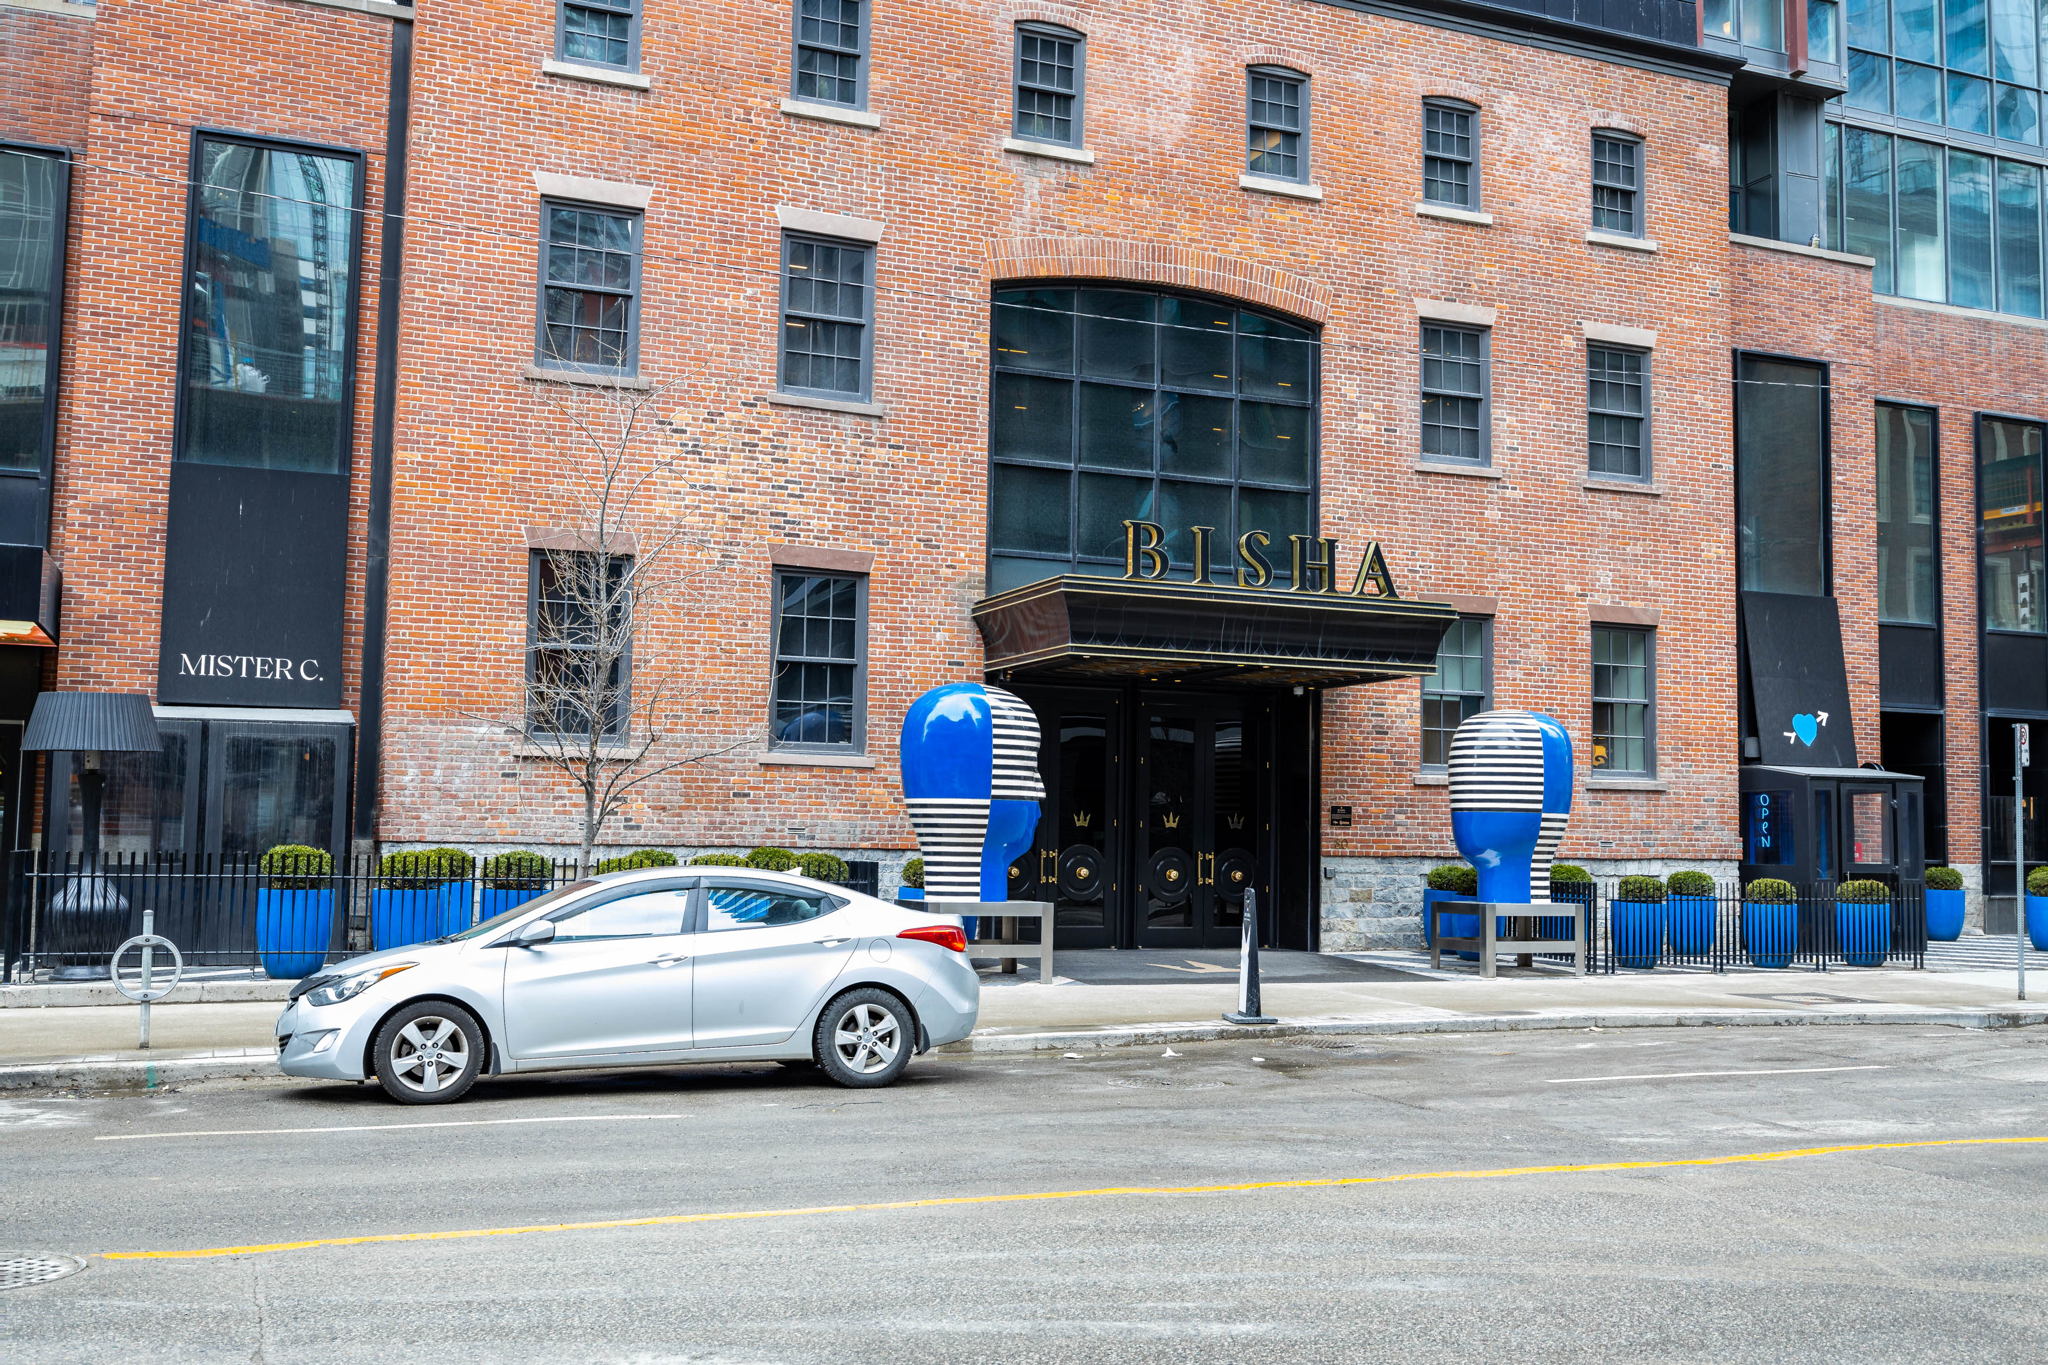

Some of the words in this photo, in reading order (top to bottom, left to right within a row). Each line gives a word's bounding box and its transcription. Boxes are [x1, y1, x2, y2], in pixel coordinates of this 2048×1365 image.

[1122, 519, 1400, 599] BISHA
[178, 653, 294, 680] MISTER
[299, 659, 324, 682] C.
